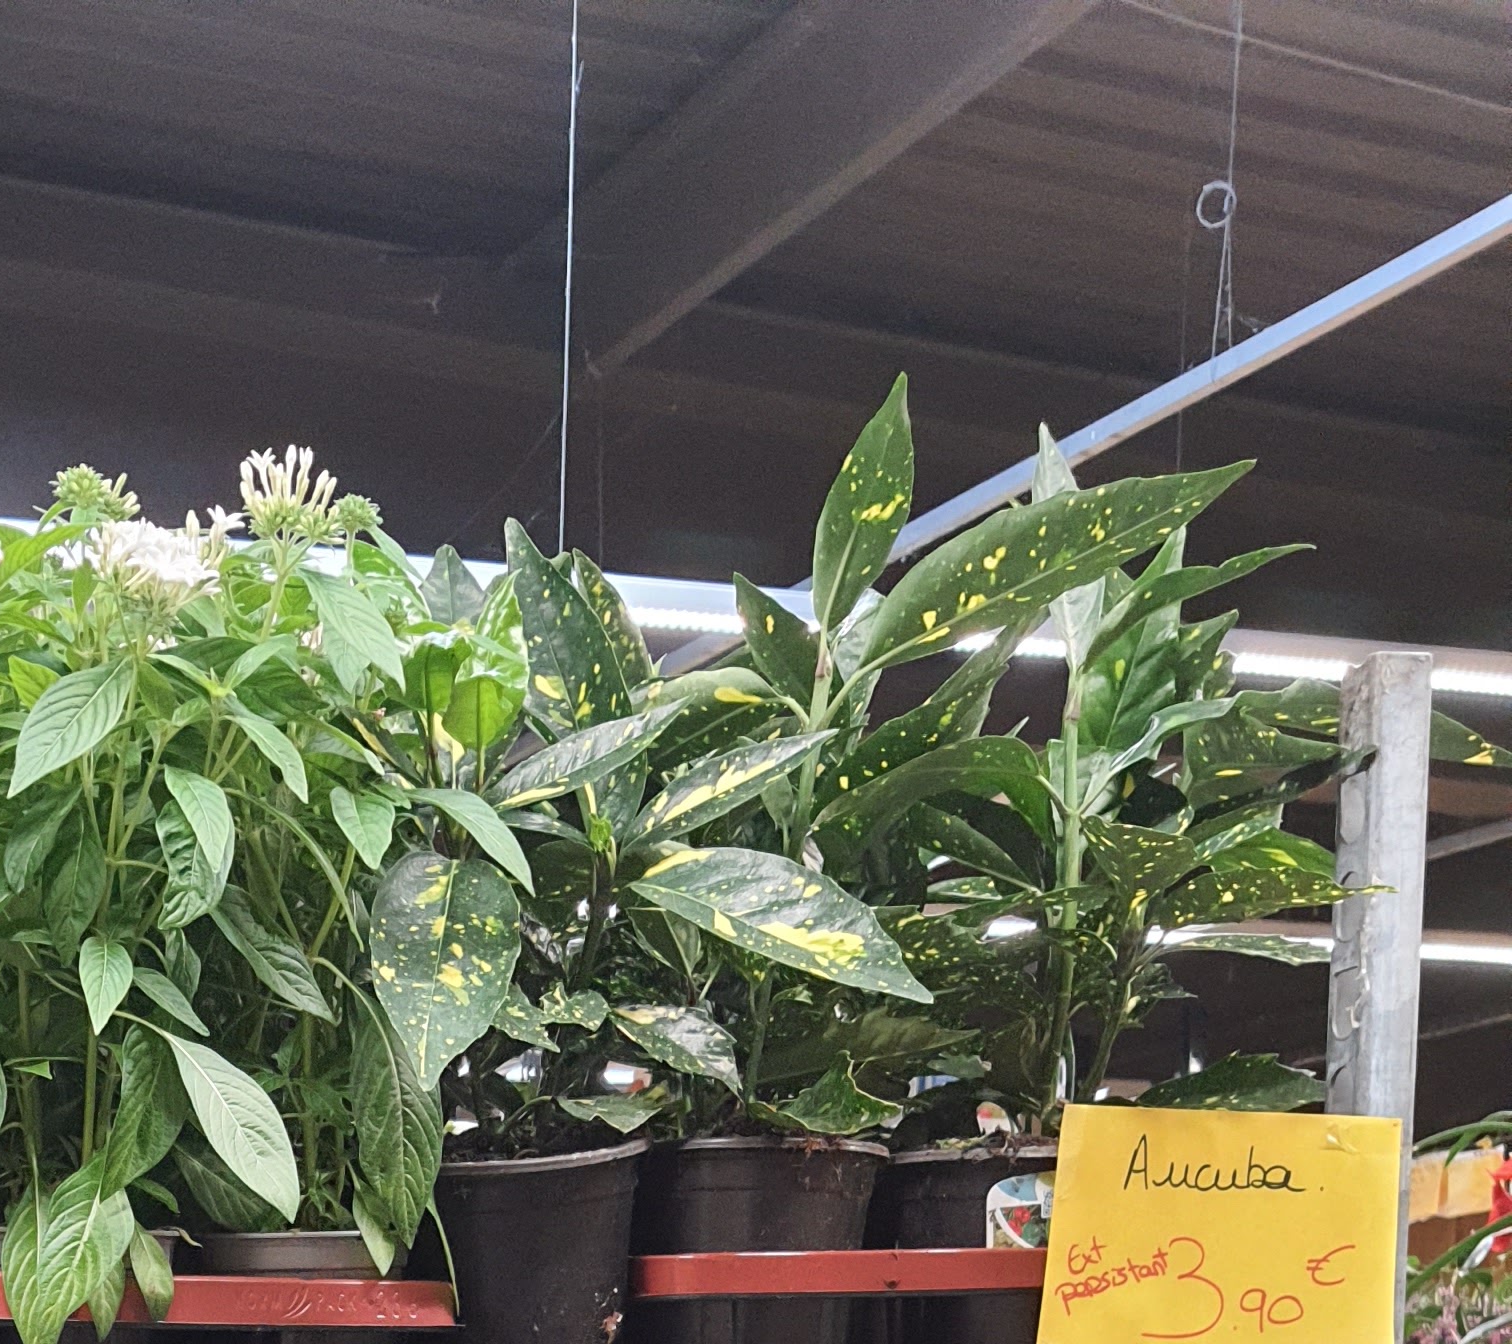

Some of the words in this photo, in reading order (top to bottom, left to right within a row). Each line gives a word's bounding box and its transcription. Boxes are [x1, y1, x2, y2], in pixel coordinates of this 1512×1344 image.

[1067, 1235, 1108, 1276] Ext
[1141, 1236, 1304, 1340] 3.90
[1305, 1244, 1357, 1287] €
